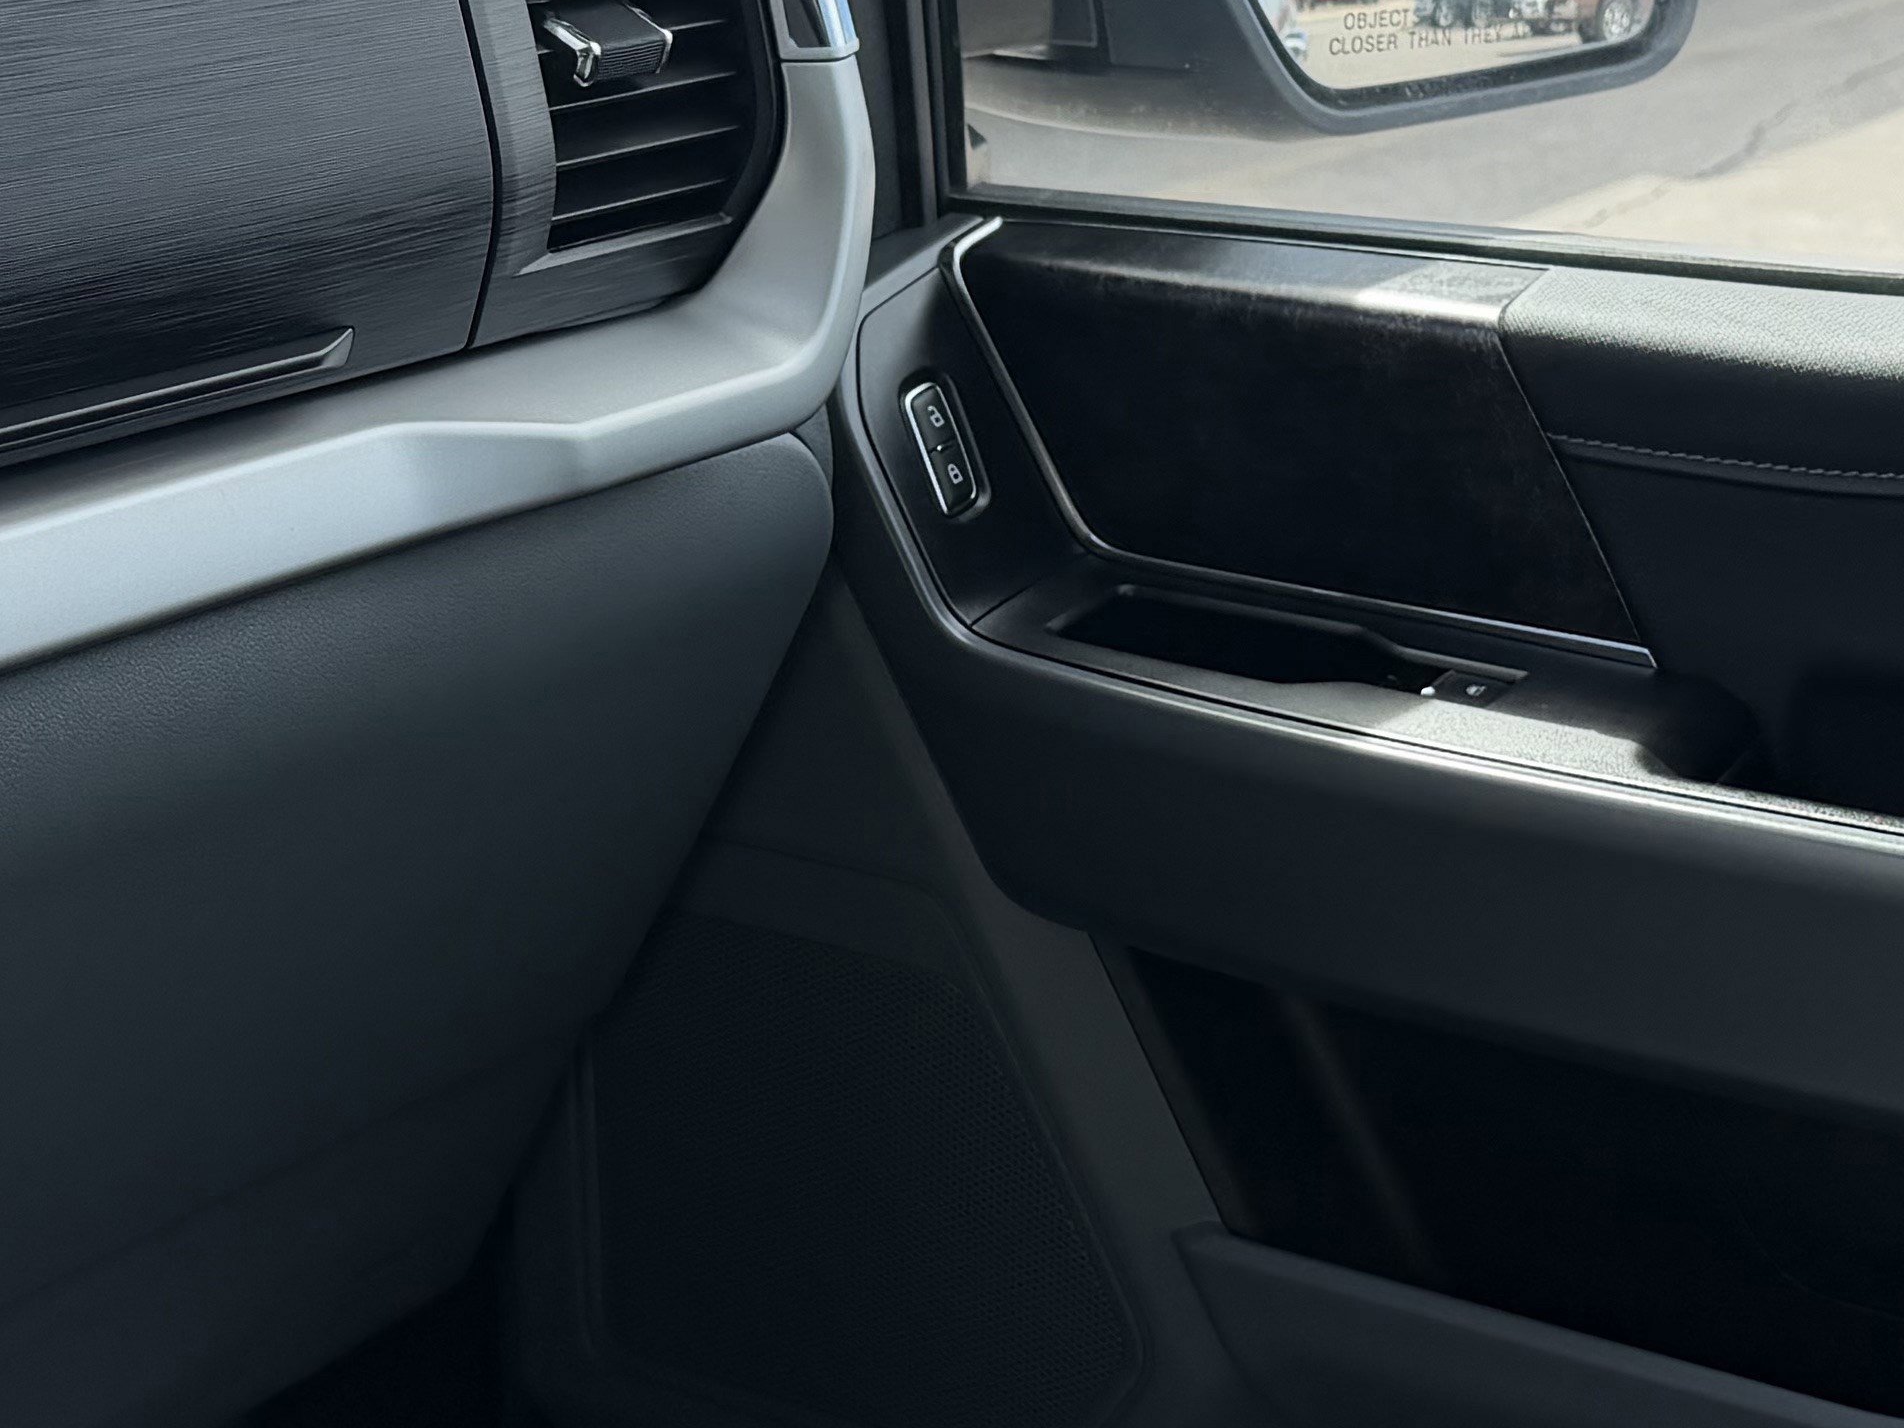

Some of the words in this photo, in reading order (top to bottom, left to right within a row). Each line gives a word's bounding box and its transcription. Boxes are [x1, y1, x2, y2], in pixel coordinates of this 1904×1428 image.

[1343, 8, 1417, 30] OBJECT
[1329, 32, 1397, 56] CLOSER
[1409, 29, 1453, 51] THAN
